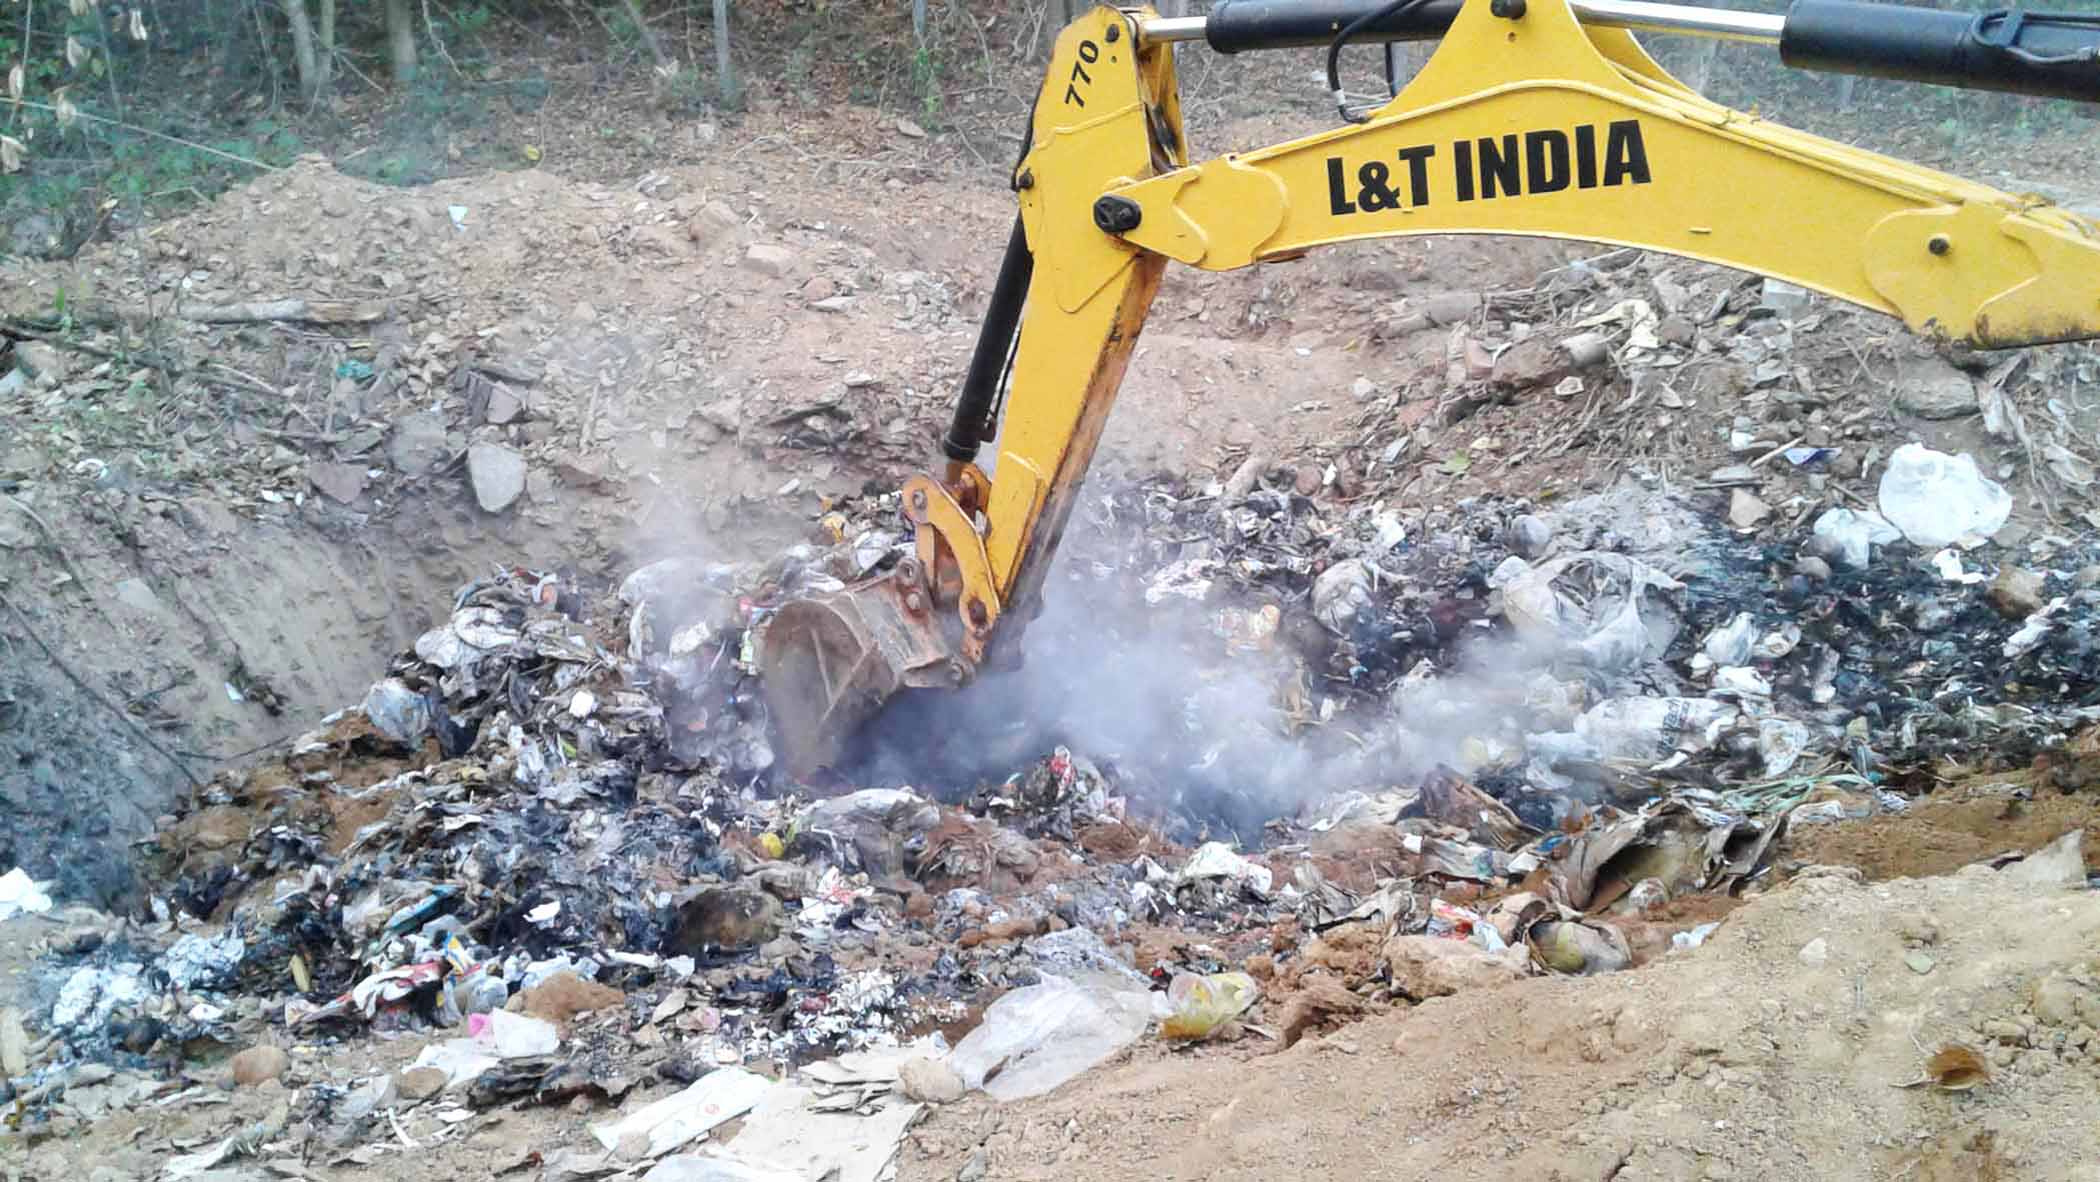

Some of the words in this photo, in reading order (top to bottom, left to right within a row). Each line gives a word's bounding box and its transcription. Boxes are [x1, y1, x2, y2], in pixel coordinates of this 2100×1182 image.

[1064, 40, 1099, 107] 770
[1327, 145, 1435, 216] L&T
[1454, 119, 1651, 202] INDIA
